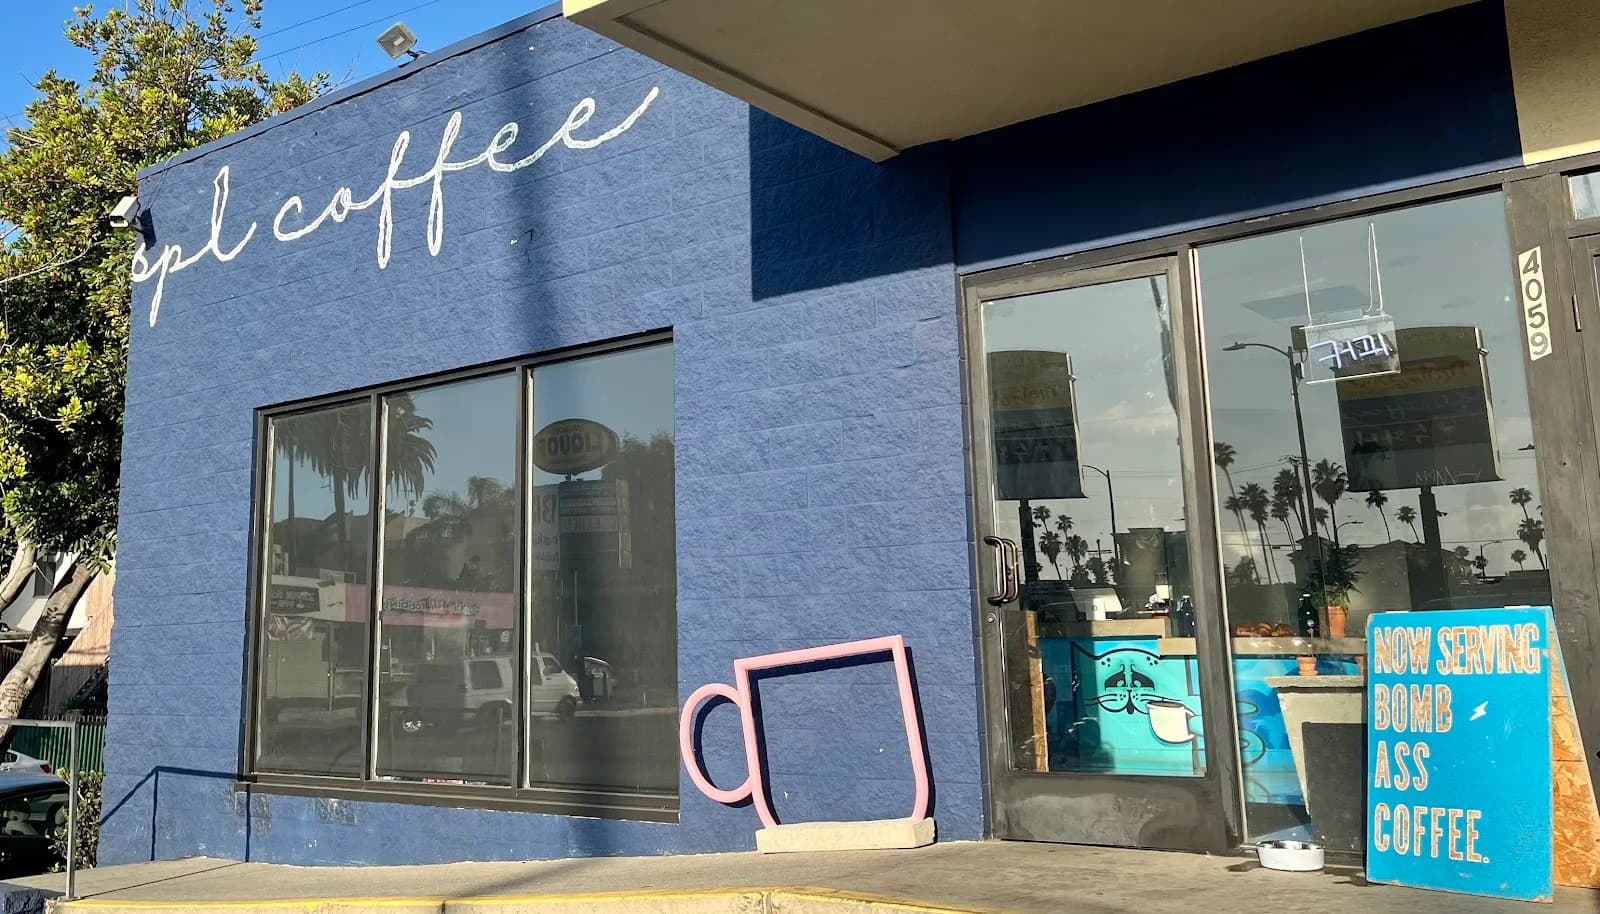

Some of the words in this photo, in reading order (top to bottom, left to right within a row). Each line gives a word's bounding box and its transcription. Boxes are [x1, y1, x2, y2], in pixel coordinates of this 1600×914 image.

[273, 86, 659, 269] coffee
[1522, 249, 1549, 356] 4059
[1310, 332, 1390, 369] 커피
[1374, 626, 1431, 674] NOW
[1436, 623, 1540, 675] SERVING
[1374, 683, 1453, 733] BOMB
[1374, 740, 1430, 791] ASS
[1374, 802, 1490, 864] COFFEE.
